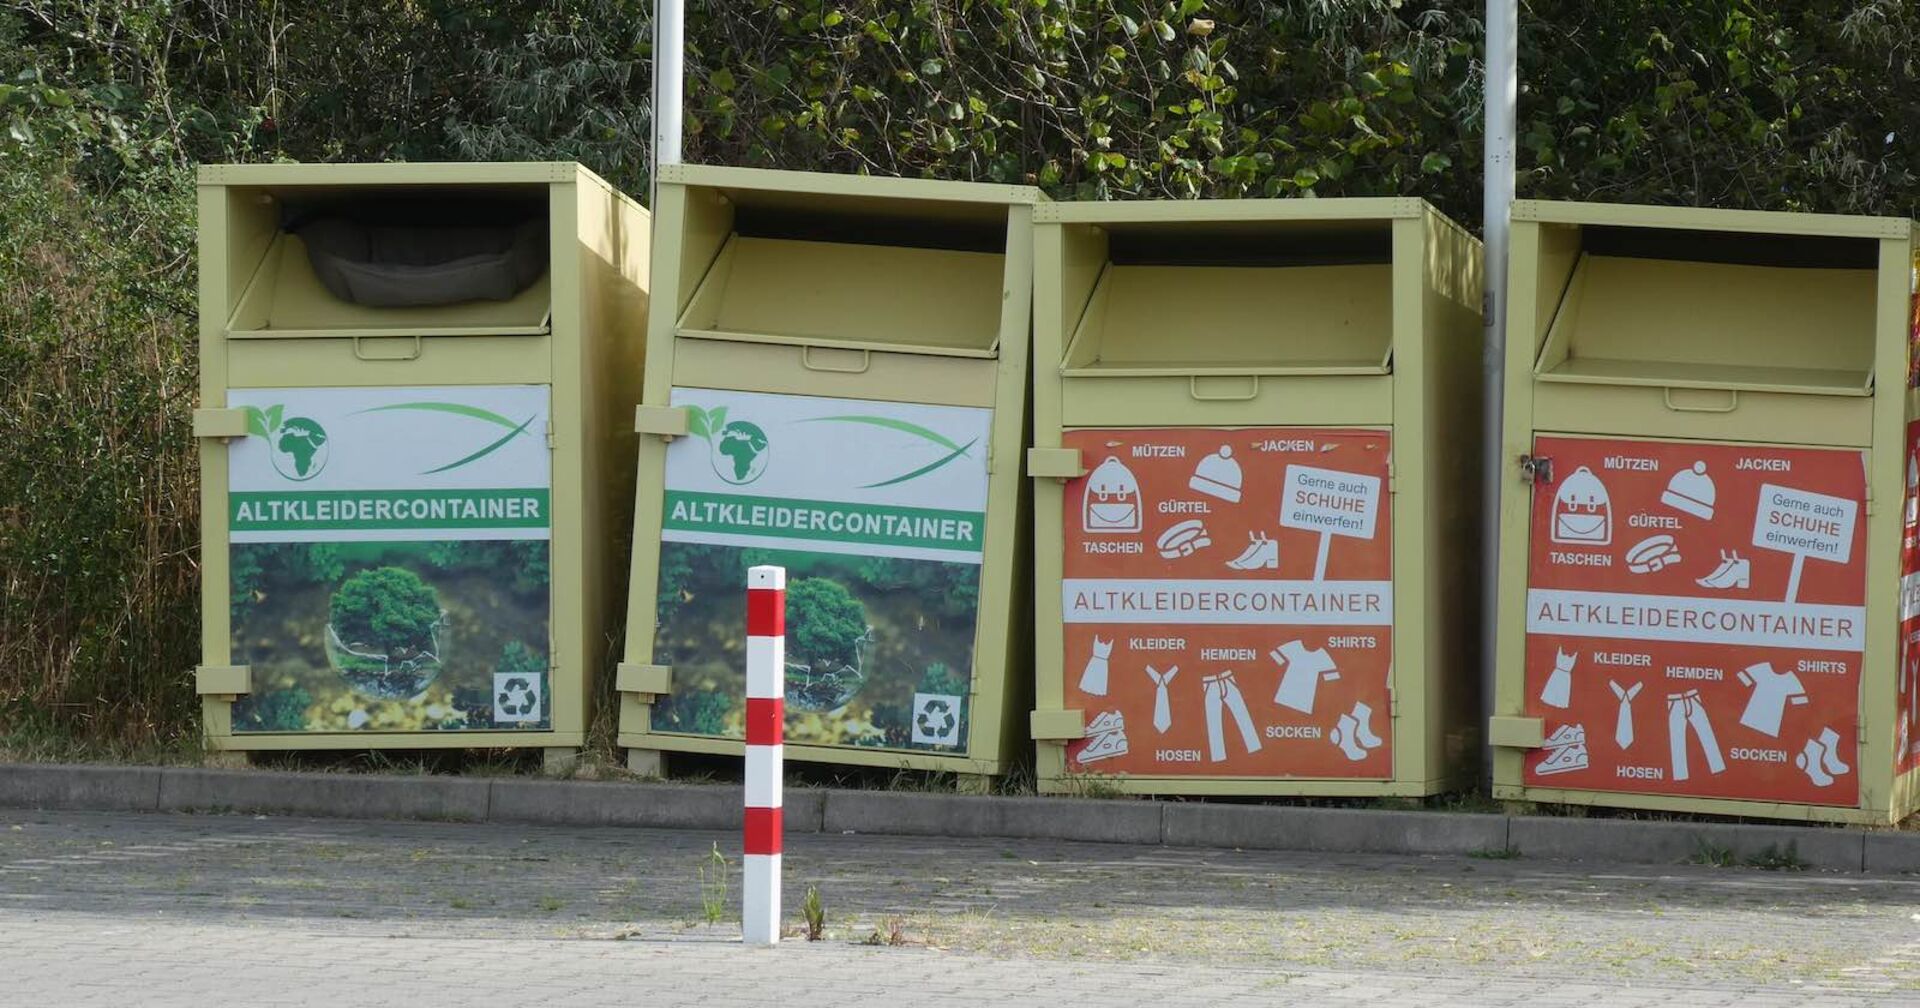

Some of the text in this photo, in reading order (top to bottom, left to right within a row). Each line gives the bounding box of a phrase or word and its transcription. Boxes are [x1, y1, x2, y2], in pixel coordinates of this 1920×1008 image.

[1132, 444, 1185, 458] MÜTZEN
[1260, 440, 1314, 452] JACKEN
[1604, 455, 1659, 472] MÜTZEN
[1736, 458, 1791, 472] JACKEN
[1298, 473, 1367, 495] Gerne auch
[1159, 500, 1212, 514] GÜRTEL
[1296, 491, 1366, 513] SCHUHE
[1772, 493, 1844, 518] Gerne auch
[237, 498, 539, 521] ALTKLEIDERCONTAINER
[672, 500, 974, 541] ALTKLEIDERCONTAINER
[1293, 511, 1364, 530] einwerfen!
[1628, 513, 1682, 529] GÜRTEL
[1769, 511, 1840, 537] SCHUHE
[1083, 542, 1143, 554] TASCHEN
[1766, 530, 1838, 554] einwerfen!
[1551, 552, 1612, 566] TASCHEN
[1074, 592, 1380, 613] ALTKLEIDERCONTAINER
[1538, 603, 1854, 638] ALTKLEIDERCONTAINER
[1130, 638, 1186, 650] KLEIDER
[1328, 636, 1376, 649] SHIRTS
[1200, 648, 1256, 660] HEMDEN
[1594, 652, 1651, 667] KLEIDER
[1666, 666, 1723, 680] HEMDEN
[1797, 660, 1847, 674] SHIRTS
[1266, 726, 1321, 738] SOCKEN
[1156, 749, 1201, 762] HOSEN
[1730, 748, 1787, 763] SOCKEN
[1617, 766, 1663, 780] HOSEN
